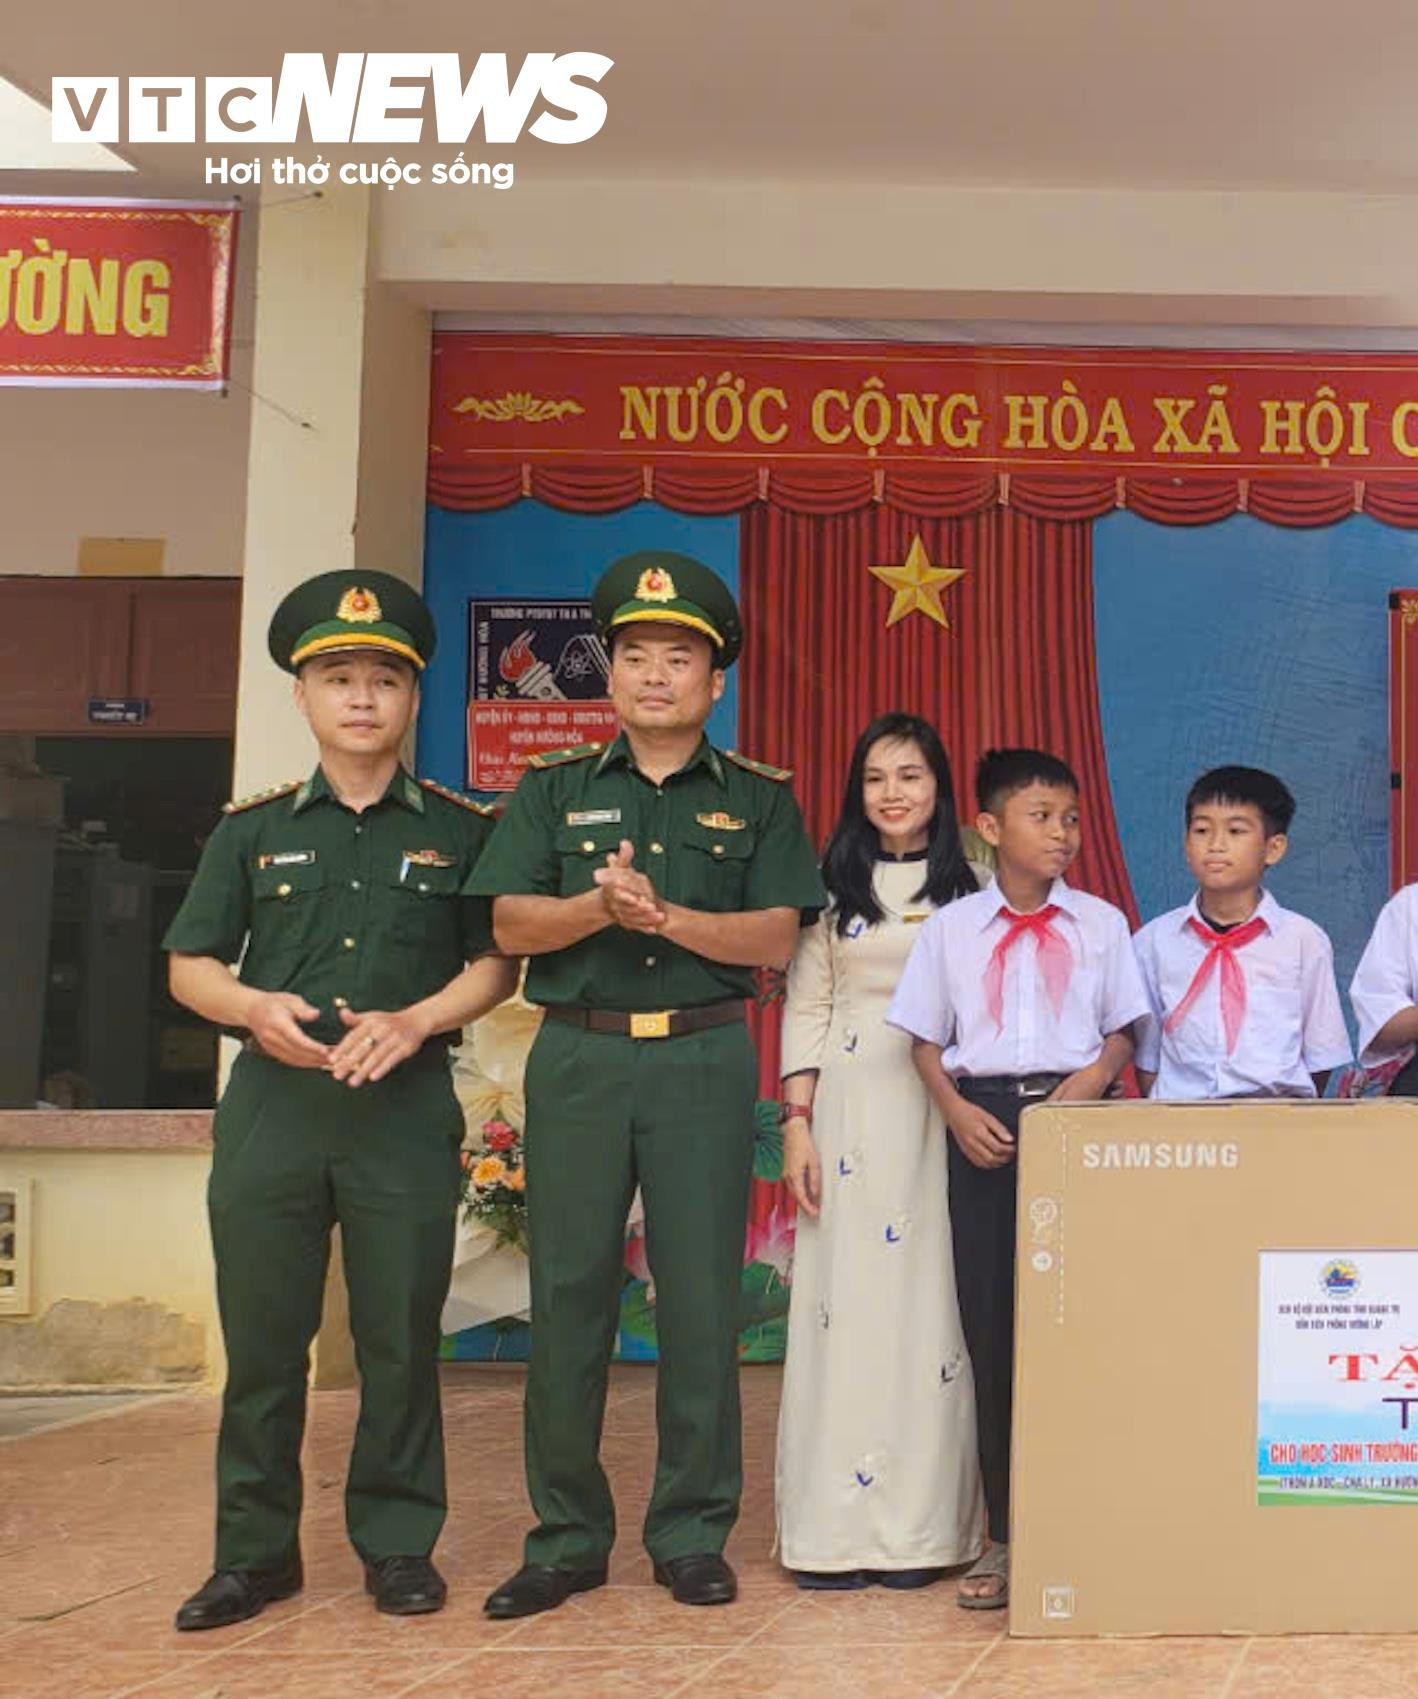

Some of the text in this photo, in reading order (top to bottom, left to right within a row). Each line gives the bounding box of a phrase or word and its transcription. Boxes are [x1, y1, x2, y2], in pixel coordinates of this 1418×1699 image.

[618, 371, 789, 444] NƯỚC
[810, 377, 982, 456] CỘNG
[1004, 380, 1135, 452] HÒA
[1152, 385, 1240, 454] XÃ
[1260, 388, 1370, 468] HỘI
[1083, 1142, 1240, 1169] SAMSUNG
[1271, 1443, 1297, 1463] CHO
[1301, 1443, 1327, 1466] HỌC
[1331, 1443, 1363, 1463] SINH
